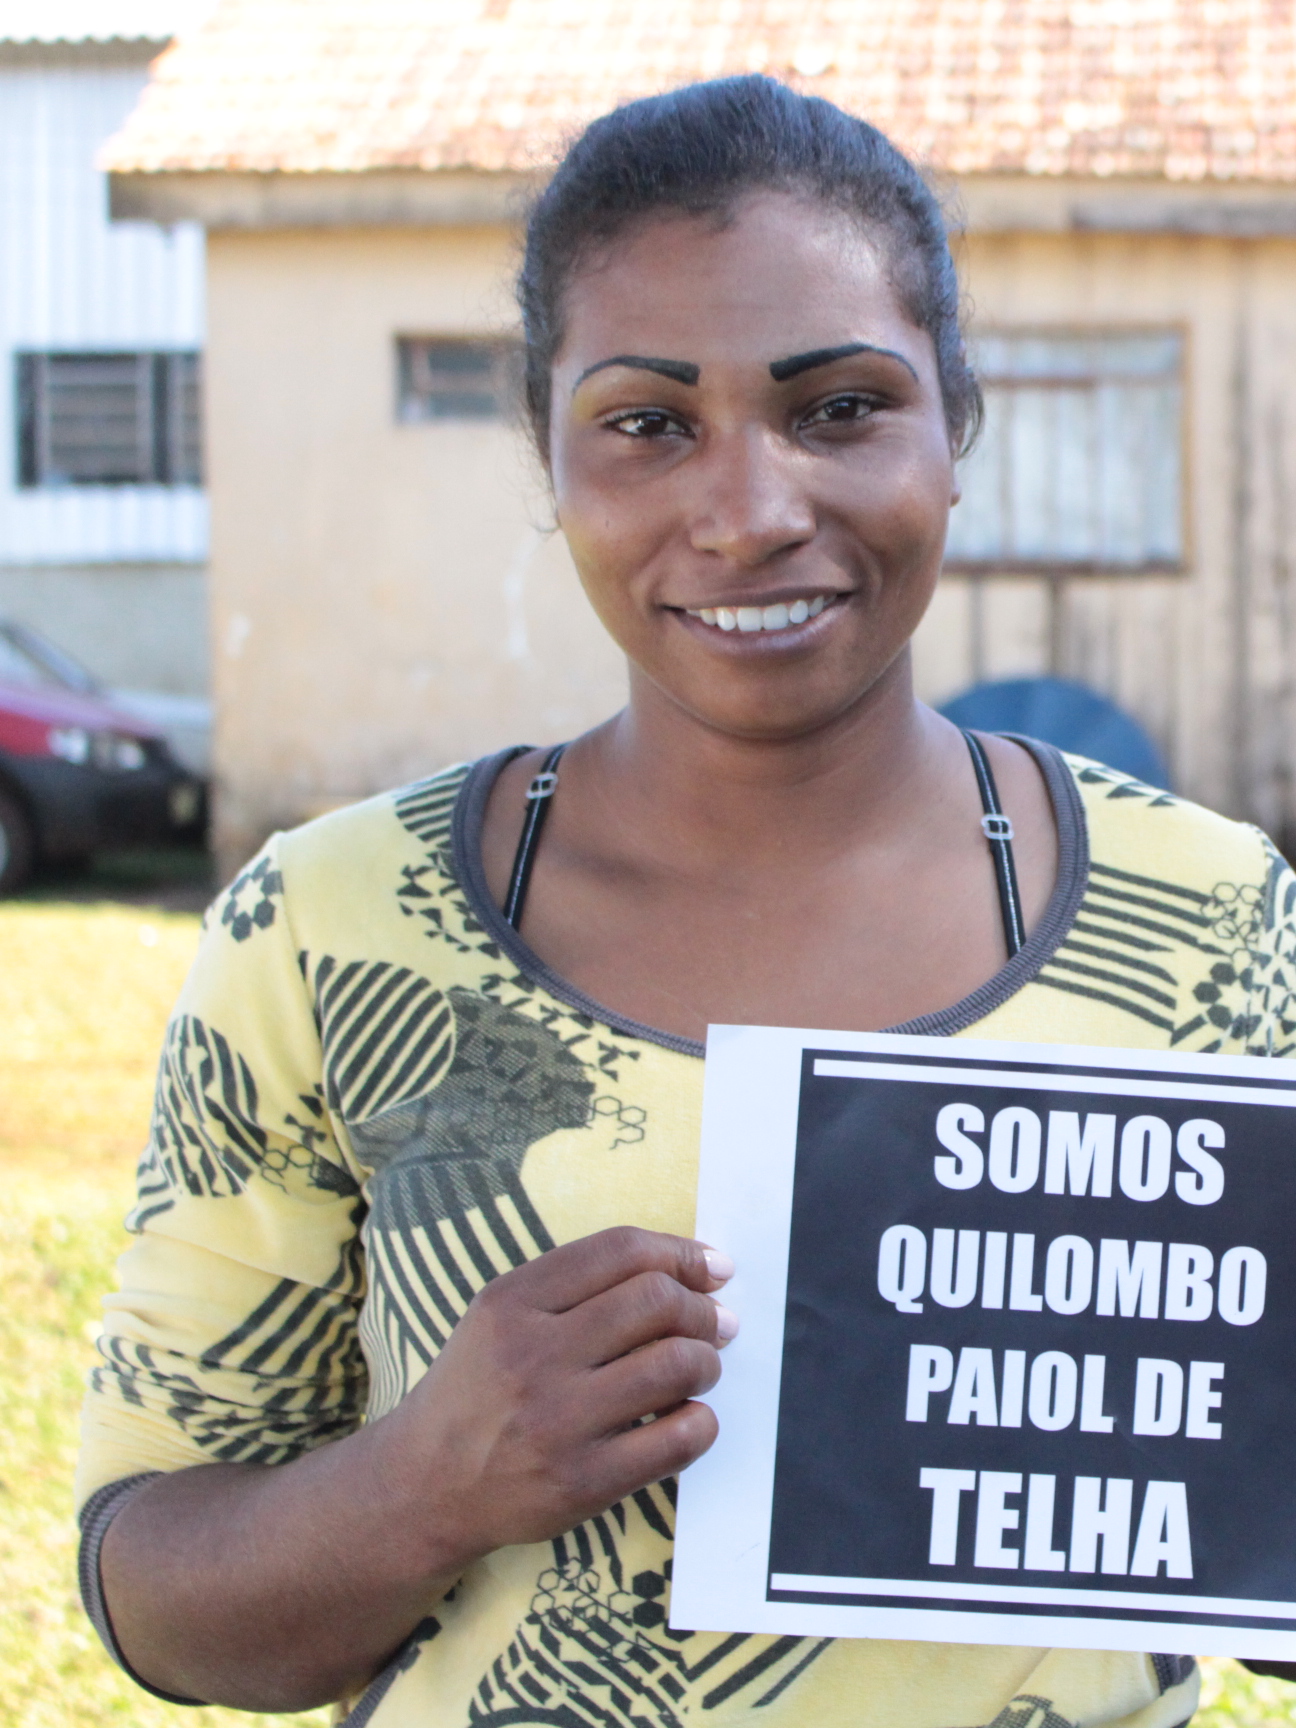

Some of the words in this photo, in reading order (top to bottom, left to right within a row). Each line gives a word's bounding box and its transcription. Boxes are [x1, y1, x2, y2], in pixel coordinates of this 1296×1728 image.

[933, 1102, 1226, 1206] SOMOS
[877, 1224, 1267, 1326] QUILOMBO
[905, 1343, 1115, 1434] PAIOL
[1132, 1357, 1225, 1440] DE
[919, 1467, 1194, 1579] TELHA
